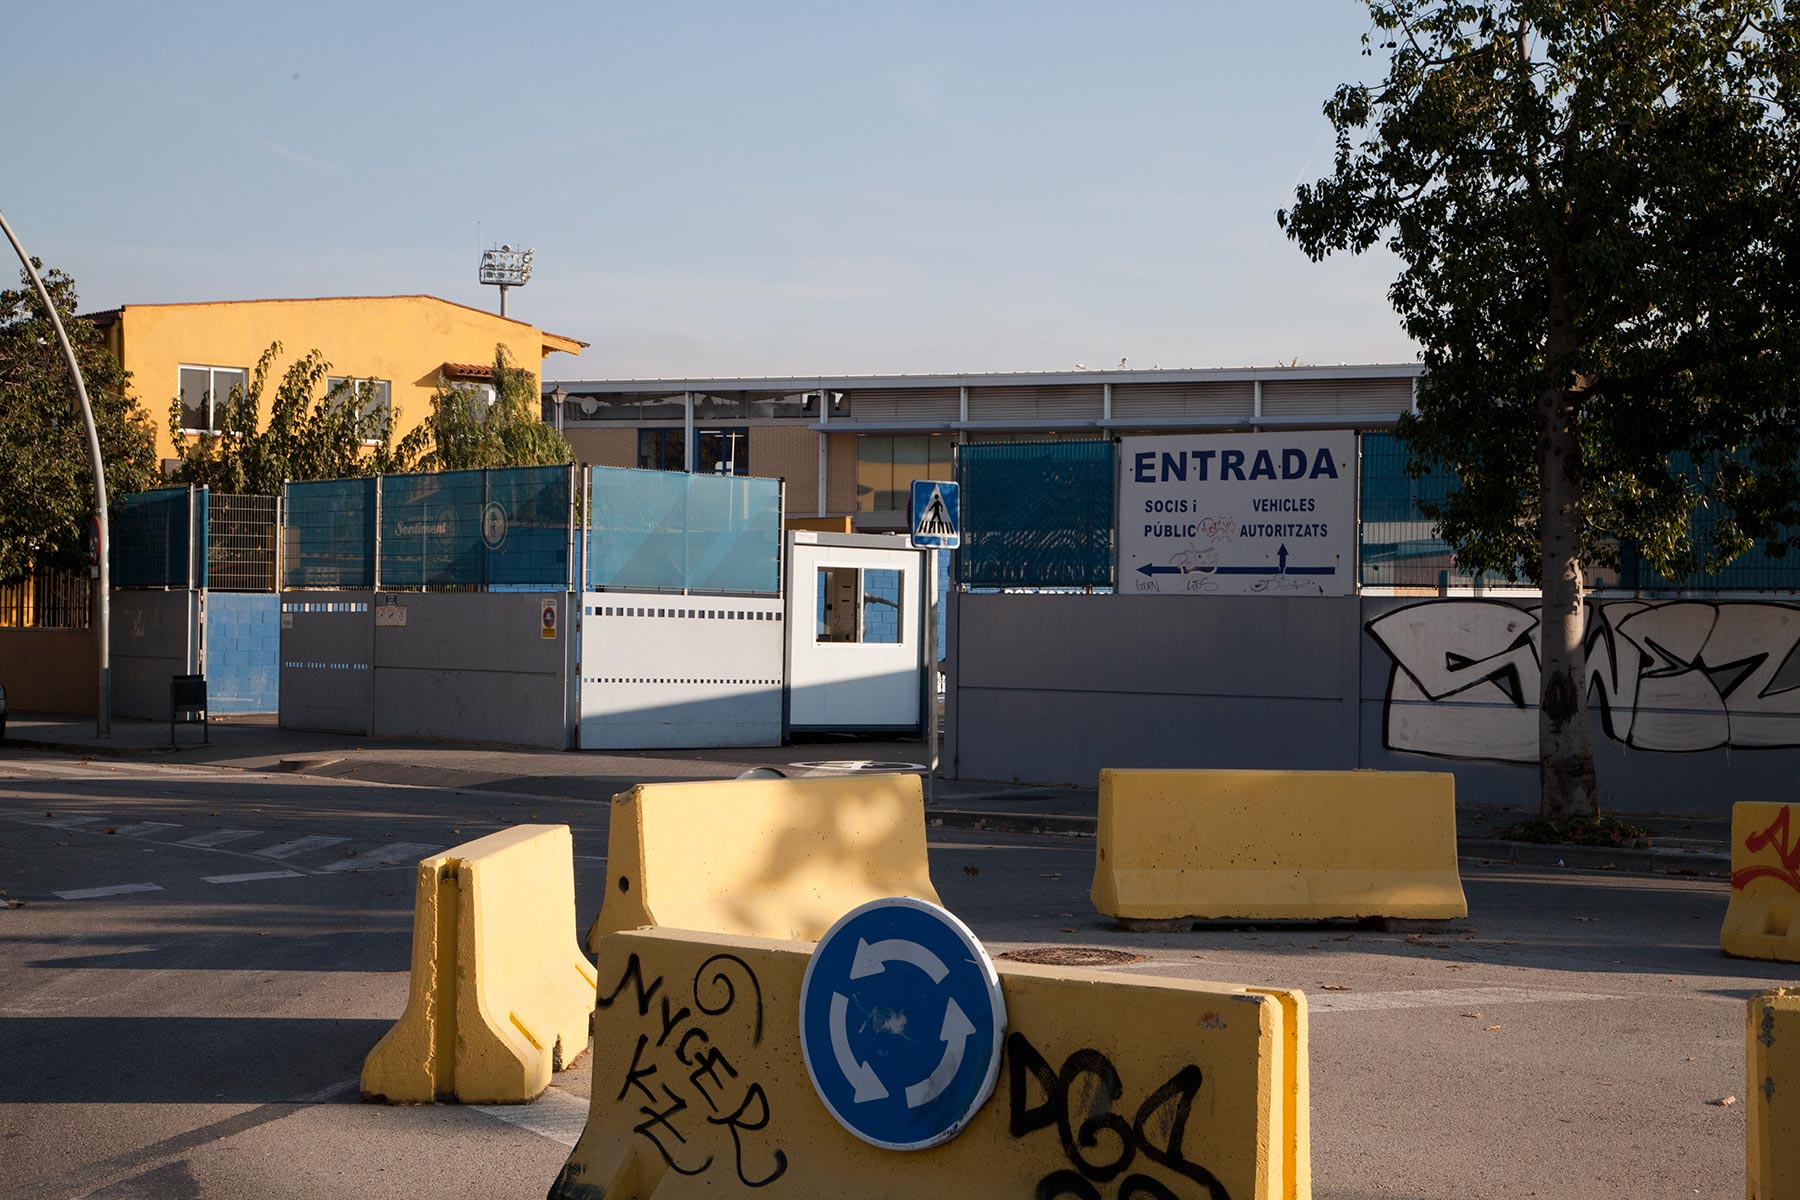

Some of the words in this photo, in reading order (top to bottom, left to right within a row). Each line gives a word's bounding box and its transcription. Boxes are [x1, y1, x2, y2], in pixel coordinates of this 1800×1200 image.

[1134, 447, 1339, 483] ENTRADA
[1144, 499, 1188, 513] SOCIS
[1192, 499, 1197, 513] i
[1252, 497, 1316, 513] VEHICLES
[394, 520, 447, 537] Sentiment
[1143, 520, 1197, 538] PÚBLIC
[1239, 523, 1329, 538] AUTORITZATS
